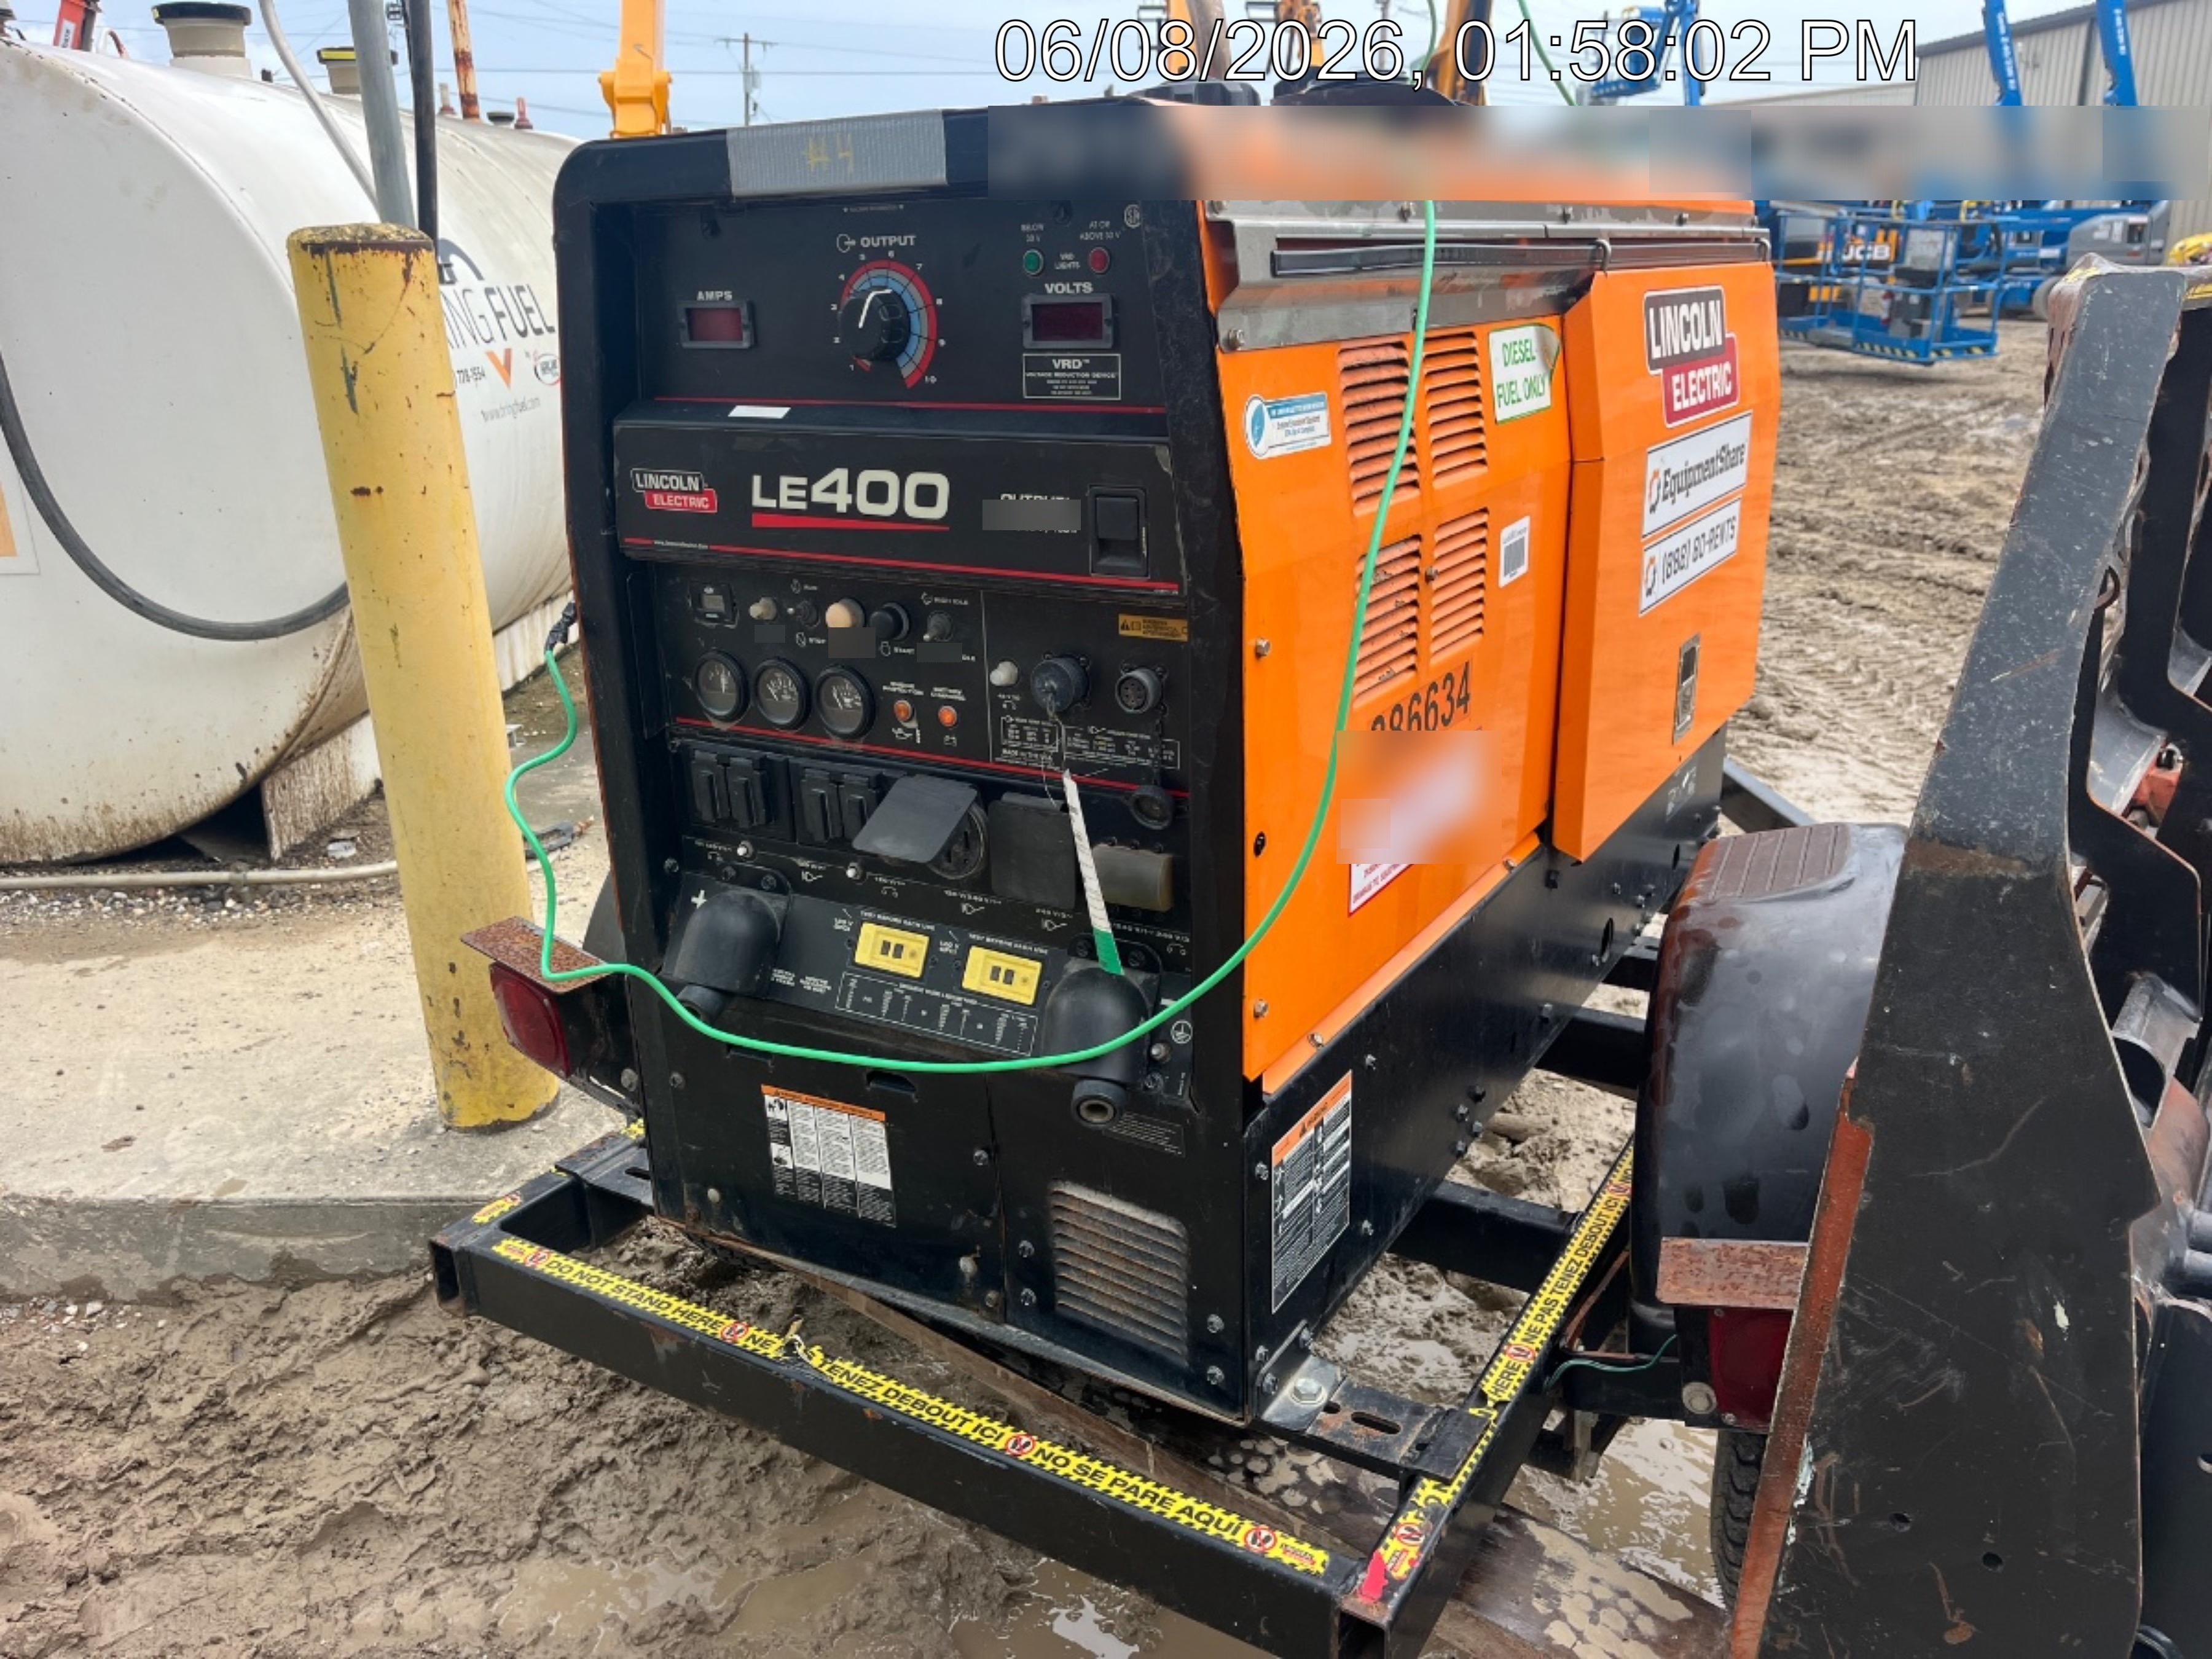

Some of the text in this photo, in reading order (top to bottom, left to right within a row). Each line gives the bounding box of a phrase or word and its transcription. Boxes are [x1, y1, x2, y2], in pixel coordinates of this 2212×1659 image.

[861, 235, 916, 248] OUTPUT
[696, 291, 733, 301] AMPS
[1045, 282, 1094, 294] VOLTS
[441, 284, 556, 350] ING FUEL
[1649, 300, 1723, 360] LINCOLN
[1502, 339, 1536, 367] DIESEL
[1497, 375, 1547, 409] FUEL ONLY
[1671, 361, 1733, 412] ELECTRIC
[635, 473, 700, 492] LINCOLN
[751, 467, 951, 520] LE400
[1661, 442, 1746, 505] EquipmentShare
[653, 493, 710, 509] ELECTRIC
[1371, 661, 1471, 731] 86634
[546, 1260, 725, 1332] DO NOT STAND HERE
[1521, 1324, 1543, 1344] NE
[1535, 1297, 1559, 1324] PAS
[1550, 1260, 1584, 1295] TENEZ
[1574, 1212, 1607, 1258] DEBOUT
[743, 1333, 777, 1351] NE
[817, 1361, 1008, 1442] TENEZ DEBOUT ICI
[1033, 1448, 1246, 1537] NO SE PARE AQUÍ
